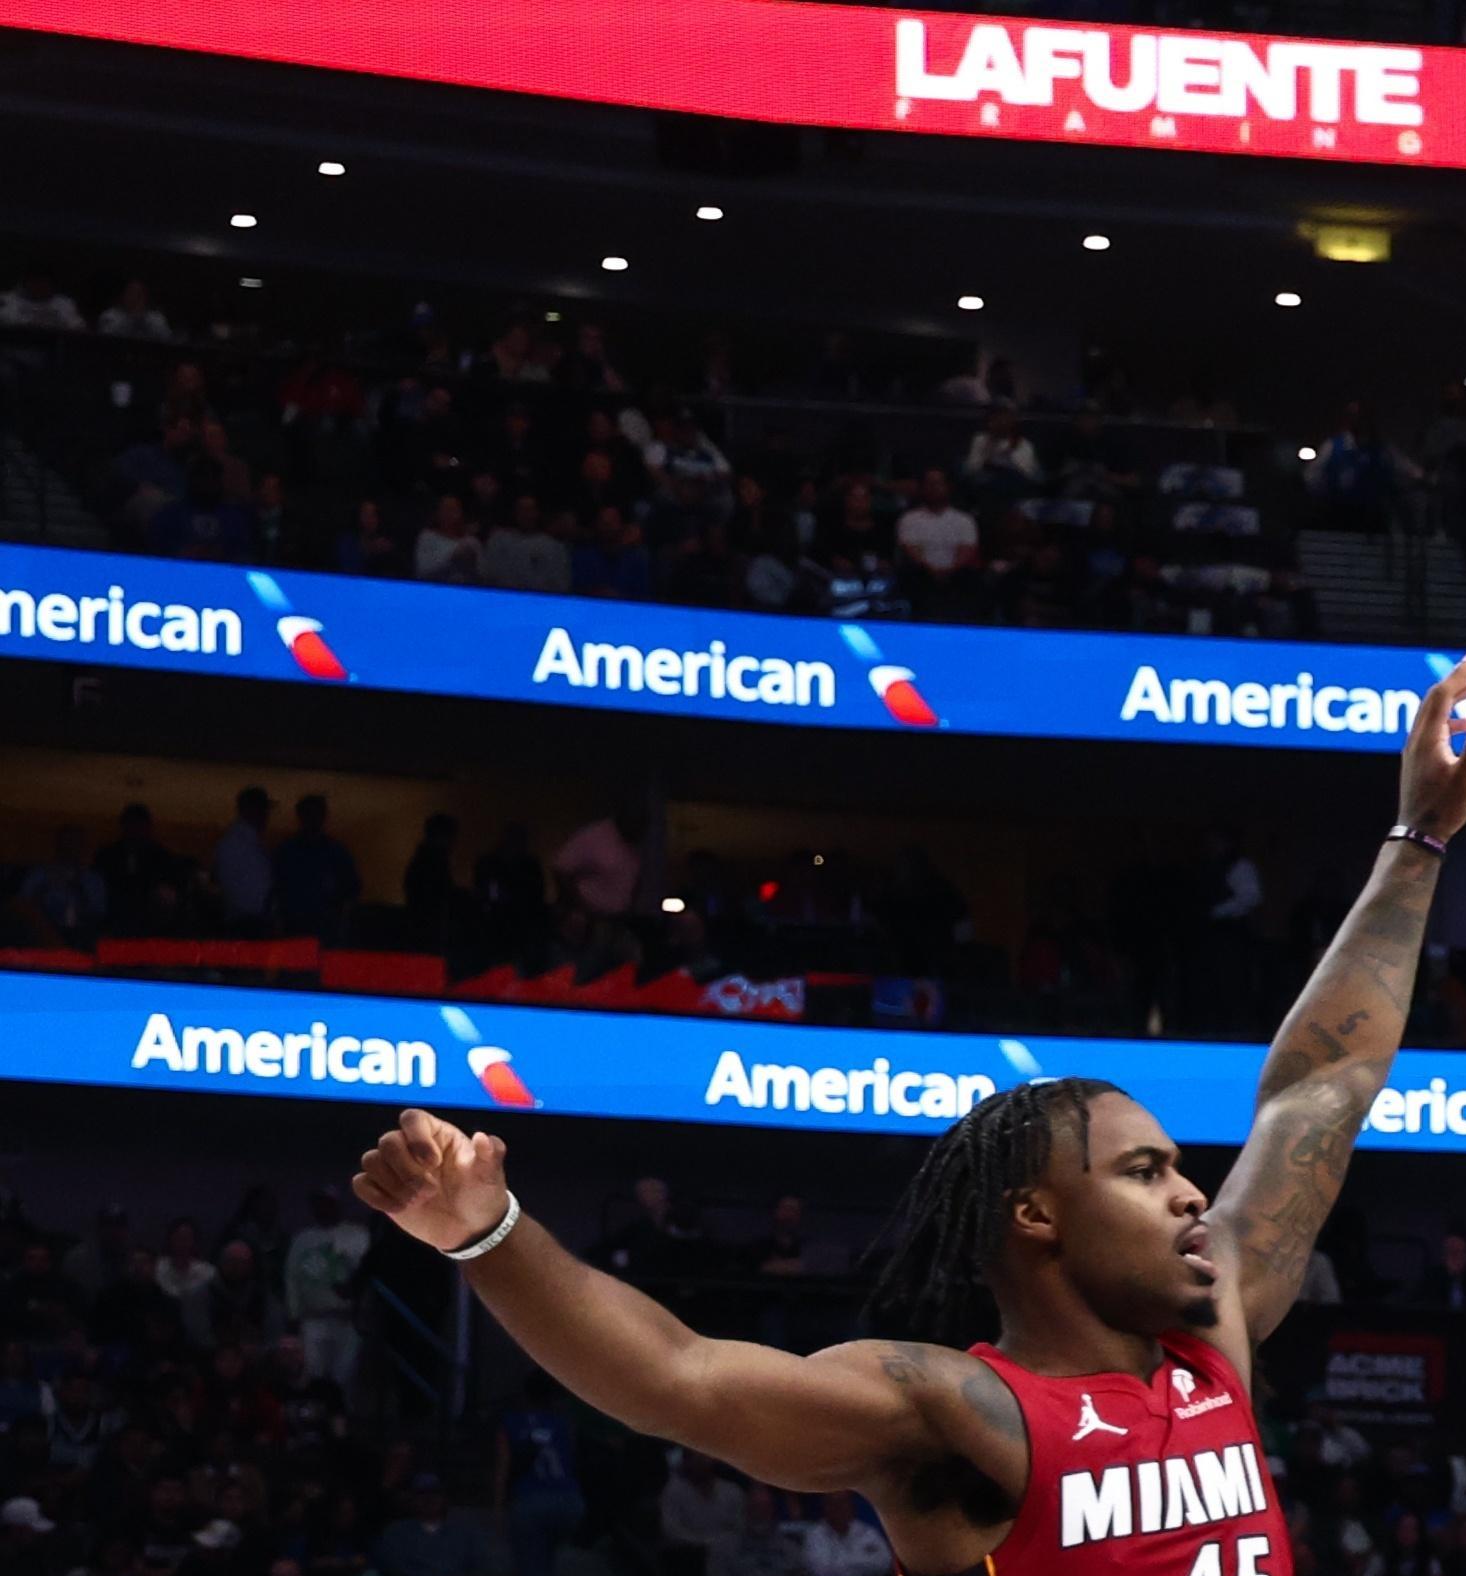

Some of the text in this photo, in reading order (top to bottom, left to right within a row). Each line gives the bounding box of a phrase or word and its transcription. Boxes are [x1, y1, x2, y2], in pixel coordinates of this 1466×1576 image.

[896, 18, 1423, 125] LAFUENTE
[533, 628, 836, 707] American
[1121, 665, 1421, 734] American
[132, 1012, 437, 1088] American
[706, 1050, 997, 1119] American
[1061, 1442, 1268, 1549] MIAMI
